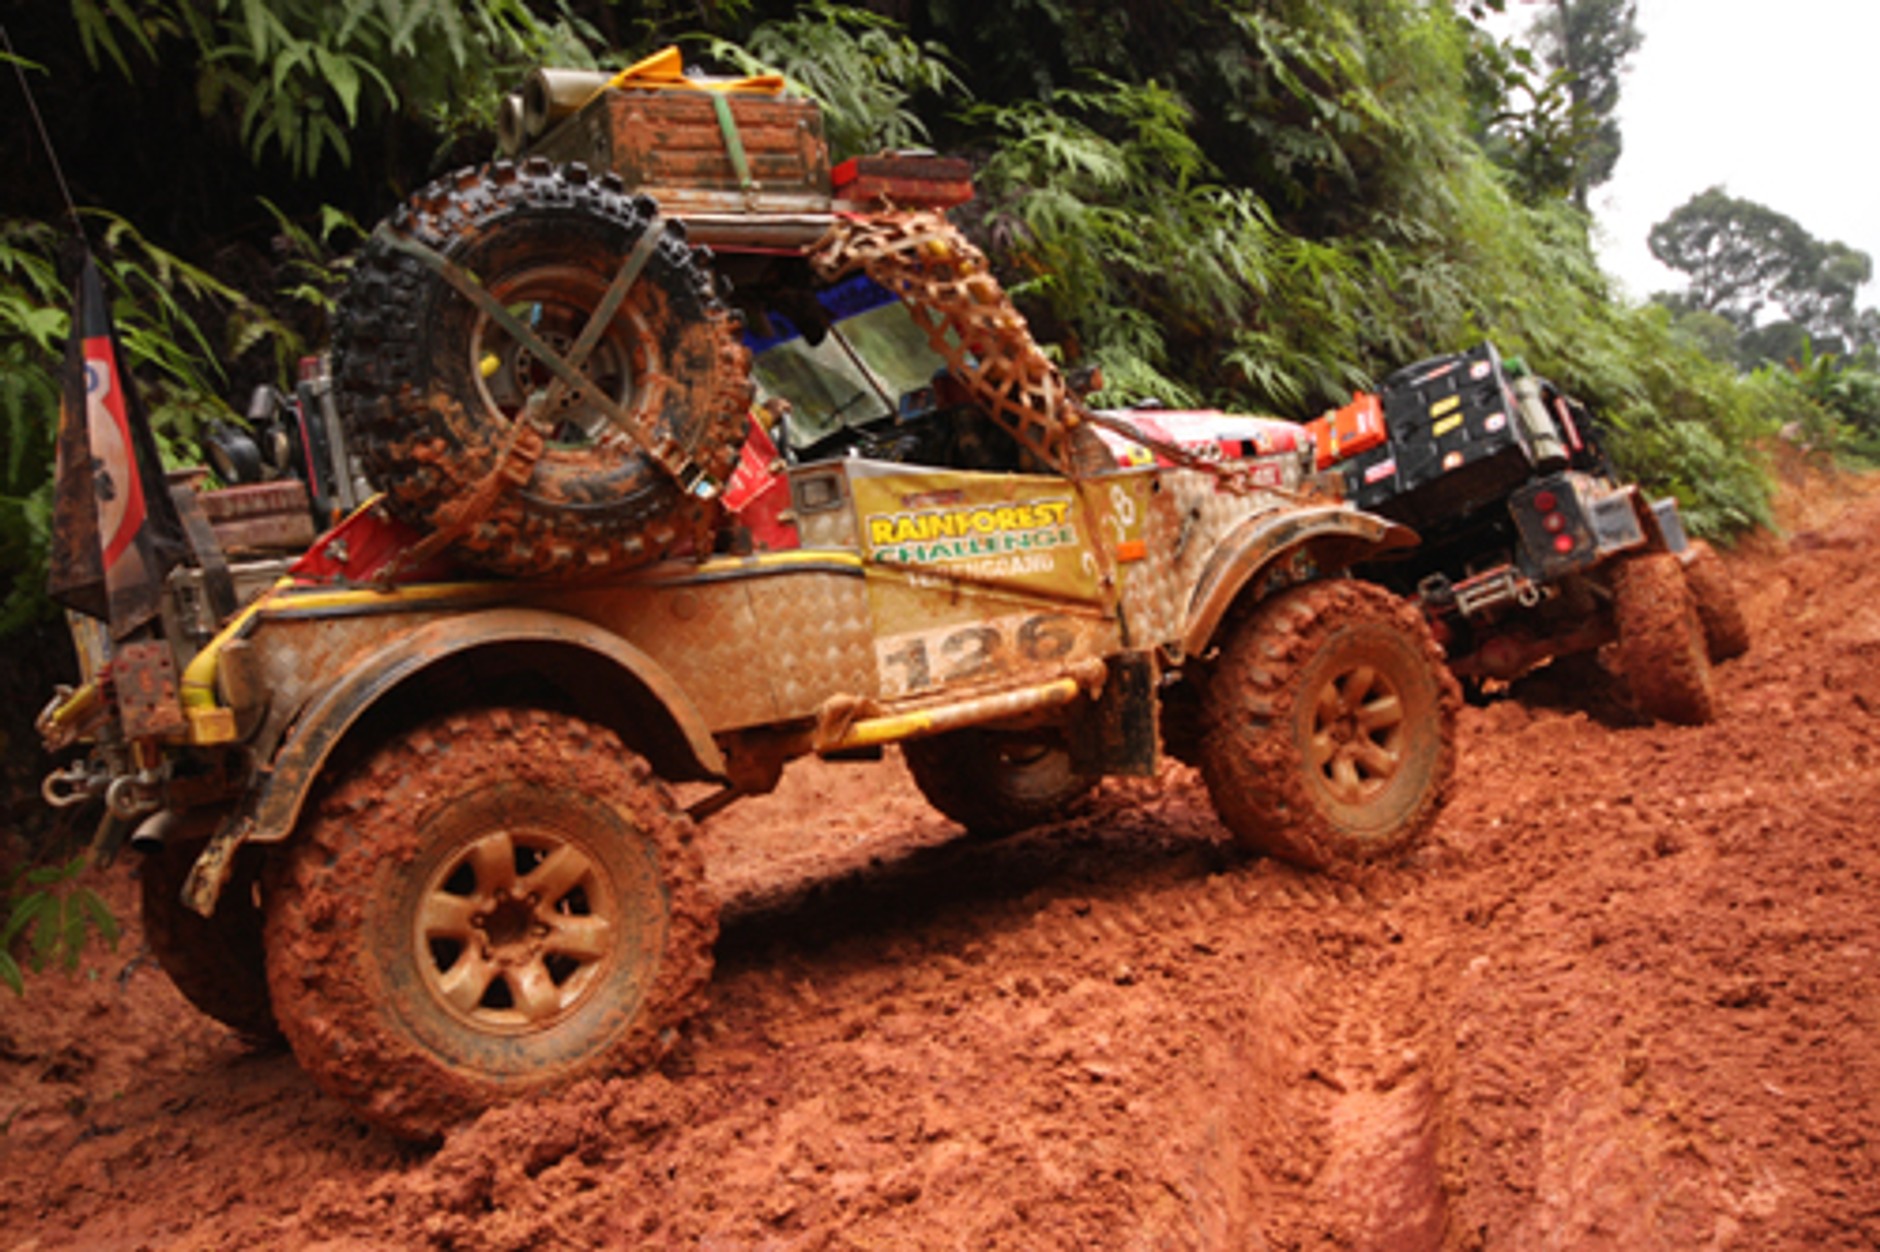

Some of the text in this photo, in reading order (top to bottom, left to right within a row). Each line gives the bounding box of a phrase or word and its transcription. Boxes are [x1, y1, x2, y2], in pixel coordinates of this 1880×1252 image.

[869, 499, 1071, 547] RAINFOREST
[874, 526, 1077, 563] CHALLENGE
[886, 614, 1080, 689] 126
